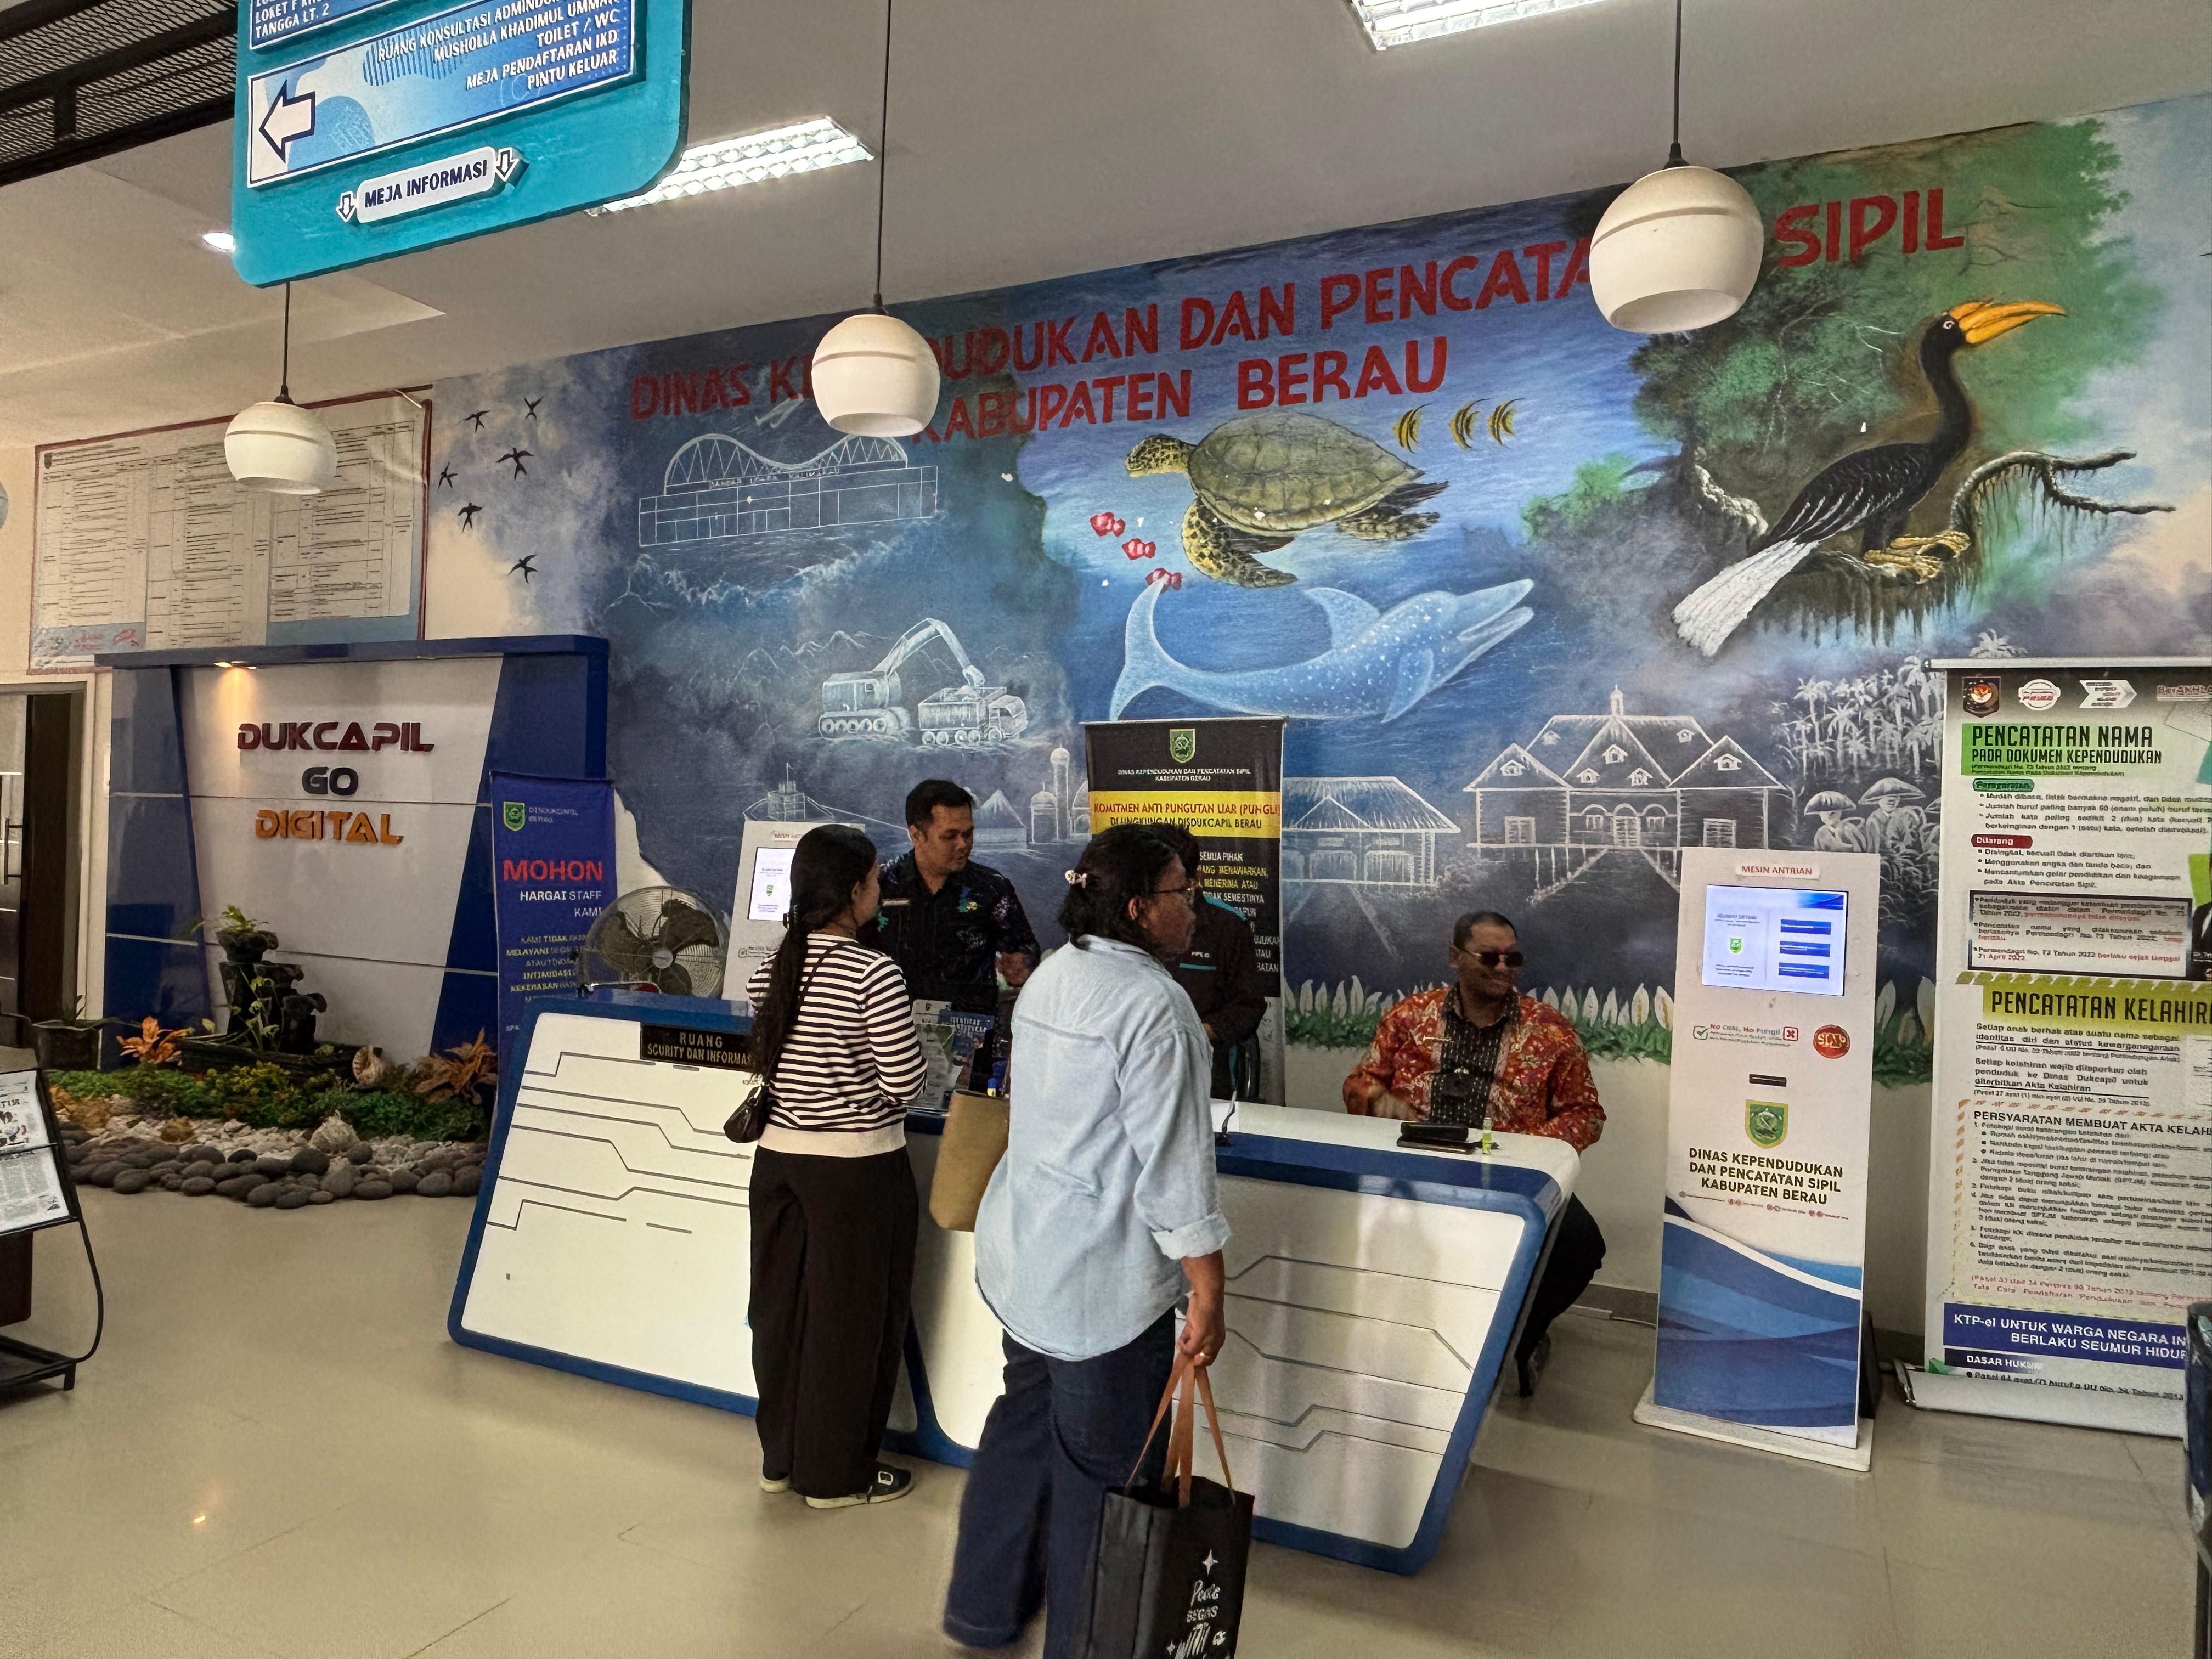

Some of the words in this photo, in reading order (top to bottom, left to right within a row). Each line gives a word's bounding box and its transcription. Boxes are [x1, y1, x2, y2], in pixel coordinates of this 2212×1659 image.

[255, 13, 300, 39] TANGGA
[321, 3, 329, 16] 2
[537, 21, 579, 48] TOILET
[595, 8, 620, 29] WC
[378, 39, 417, 61] RUANG
[420, 11, 491, 48] KONSULTASI
[435, 30, 498, 63] MUSHOLLA
[501, 7, 564, 41] KHADIMUL
[466, 67, 498, 91] MEJA
[502, 37, 592, 78] PENDAFTARAN
[596, 30, 618, 48] IKD
[528, 65, 565, 90] PINTU
[569, 49, 617, 77] KELUAR
[365, 183, 403, 208] MEJA
[407, 159, 488, 197] INFORMASI
[631, 362, 751, 420] DINAS
[1180, 283, 1296, 350] DAN
[1774, 188, 1965, 268] SIPIL
[1238, 335, 1448, 410] BERAU
[237, 721, 435, 752] DUKCAPIL
[1972, 726, 2090, 748] PENCATATAN
[2098, 726, 2153, 748] NAMA
[1972, 749, 2002, 763] PADA
[2006, 749, 2063, 763] DOKUMEN
[2067, 749, 2162, 764] KEPENDUDUKAN
[302, 766, 359, 795] GO
[1094, 803, 1139, 813] KOMITMEN
[1142, 803, 1163, 813] ANTI
[1165, 803, 1214, 814] PUNGUTAN
[1217, 804, 1237, 814] LIAR
[255, 809, 404, 845] DIGITAL
[1234, 819, 1262, 828] BERAU
[1976, 837, 2014, 846] Dilarang
[1199, 851, 1222, 861] SEMUA
[1223, 852, 1243, 862] PIHAK
[503, 859, 603, 882] MOHON
[520, 891, 567, 901] HARGAI
[569, 890, 602, 900] STAFF
[1991, 991, 2116, 1020] PENCATATAN
[2124, 998, 2212, 1024] KELAHIR
[679, 1032, 723, 1048] RUANG
[1976, 1023, 2004, 1033] Setiap
[2030, 1027, 2062, 1035] berhak
[1976, 1034, 2015, 1042] identitas
[647, 1043, 685, 1059] SCURITY
[687, 1047, 704, 1061] DAN
[707, 1049, 752, 1065] INFORMAS
[1975, 1058, 2004, 1066] Setiap
[2005, 1059, 2047, 1069] kelahiran
[1975, 1069, 2019, 1077] penduduk
[2043, 1072, 2069, 1081] Dinas
[2025, 1080, 2045, 1089] Akta
[1974, 1110, 2062, 1126] PERSYARATAN
[2066, 1118, 2129, 1131] MEMBUAT
[2130, 1122, 2164, 1134] AKTA
[1689, 1147, 1728, 1163] DINAS
[1731, 1153, 1843, 1178] KEPENDUDUKAN
[1689, 1161, 1716, 1175] DAN
[1720, 1165, 1804, 1188] PENCATATAN
[1807, 1177, 1842, 1193] SIPIL
[1701, 1177, 1779, 1198] KABUPATEN
[1782, 1189, 1828, 1205] BERAU
[1954, 1314, 1996, 1327] KTP-el
[2000, 1318, 2047, 1333] UNTUK
[2052, 1323, 2104, 1339] WARGA
[2108, 1329, 2172, 1344] NEGARA
[2172, 1335, 2187, 1346] IN
[2011, 1333, 2077, 1349] BERLAKU
[2080, 1339, 2141, 1356] SEUMUR
[1966, 1355, 2002, 1366] DASAR
